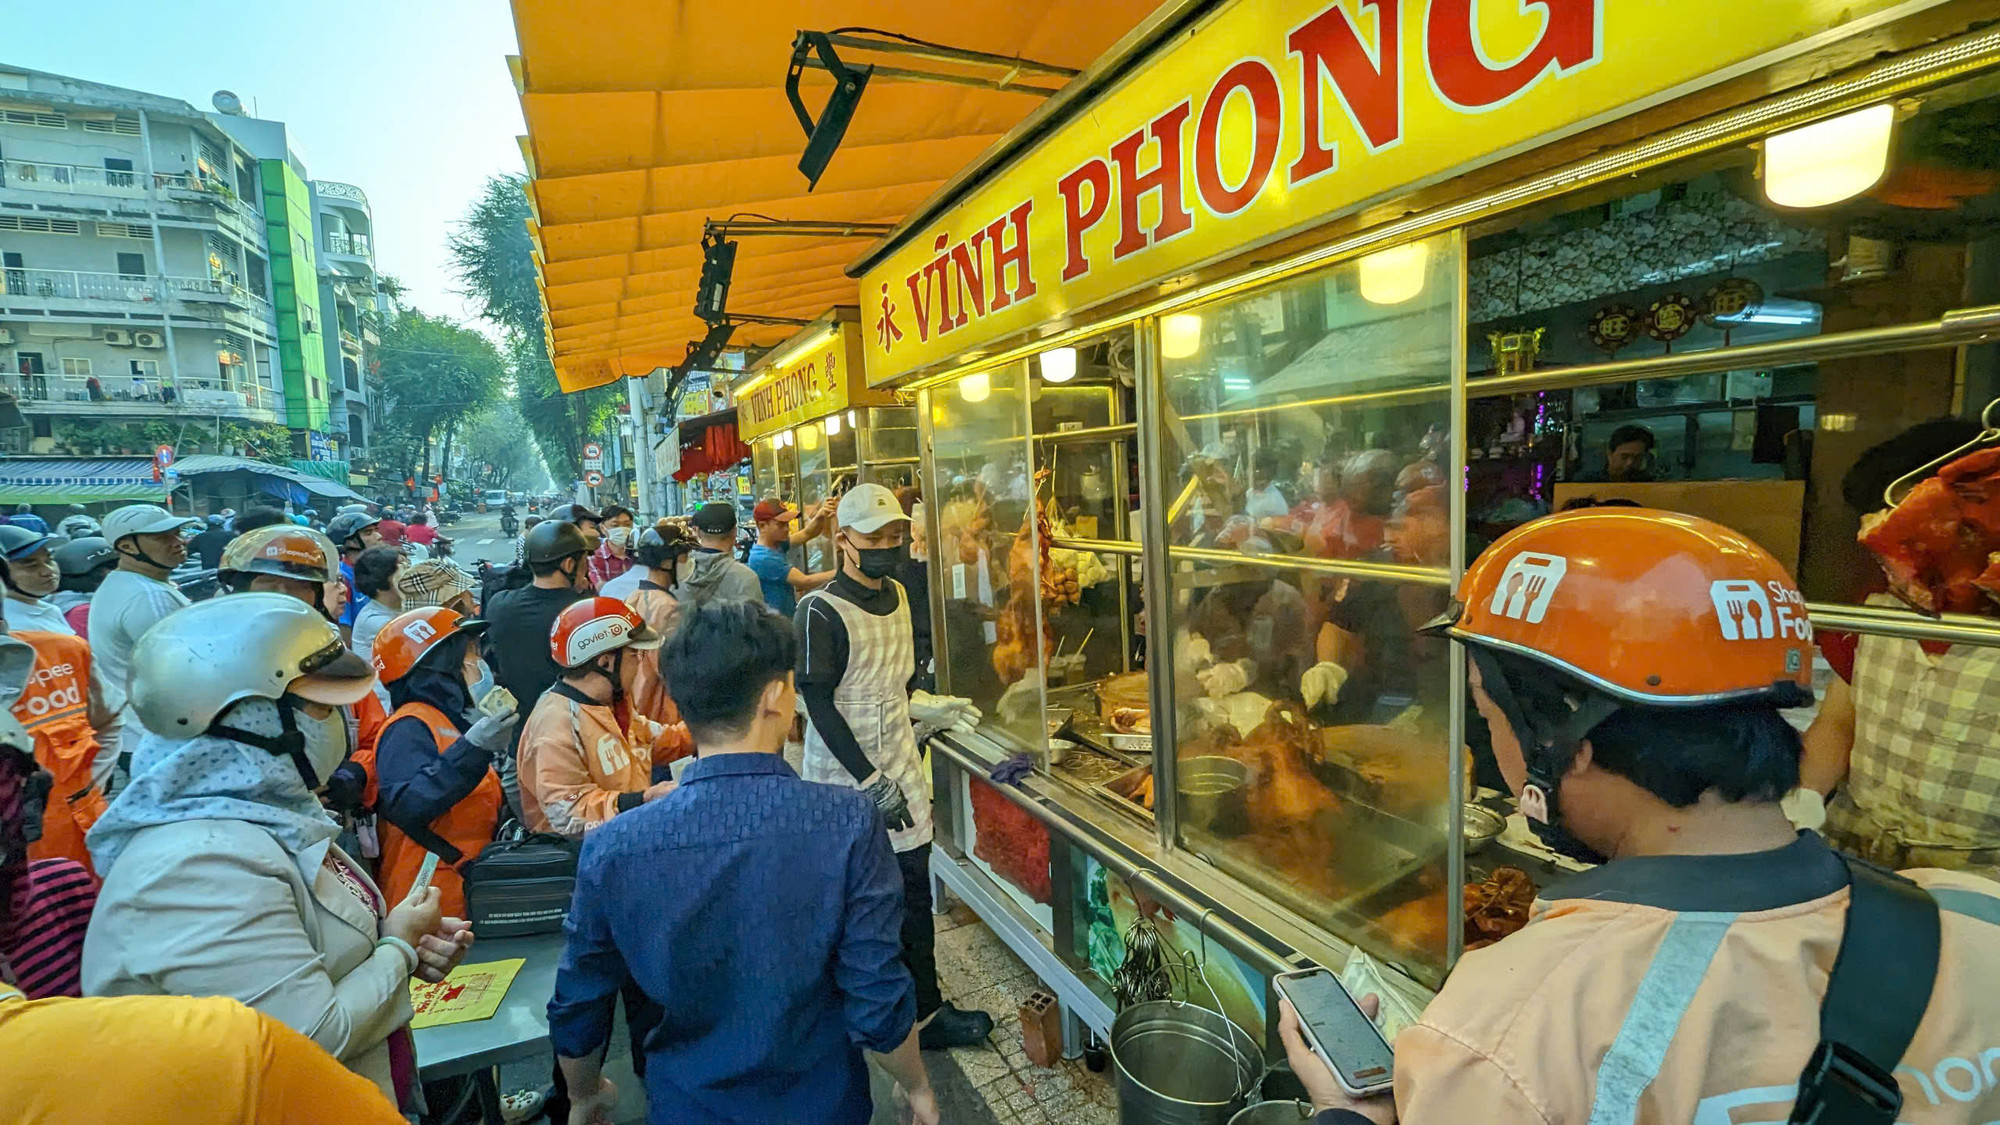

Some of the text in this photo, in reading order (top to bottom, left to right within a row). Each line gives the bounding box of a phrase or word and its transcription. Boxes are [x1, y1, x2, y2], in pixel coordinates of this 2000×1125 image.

[905, 0, 1602, 345] VĨNH PHONG
[876, 281, 904, 355] 永
[775, 362, 818, 413] PHONG
[13, 677, 80, 715] ood
[29, 663, 74, 688] pee
